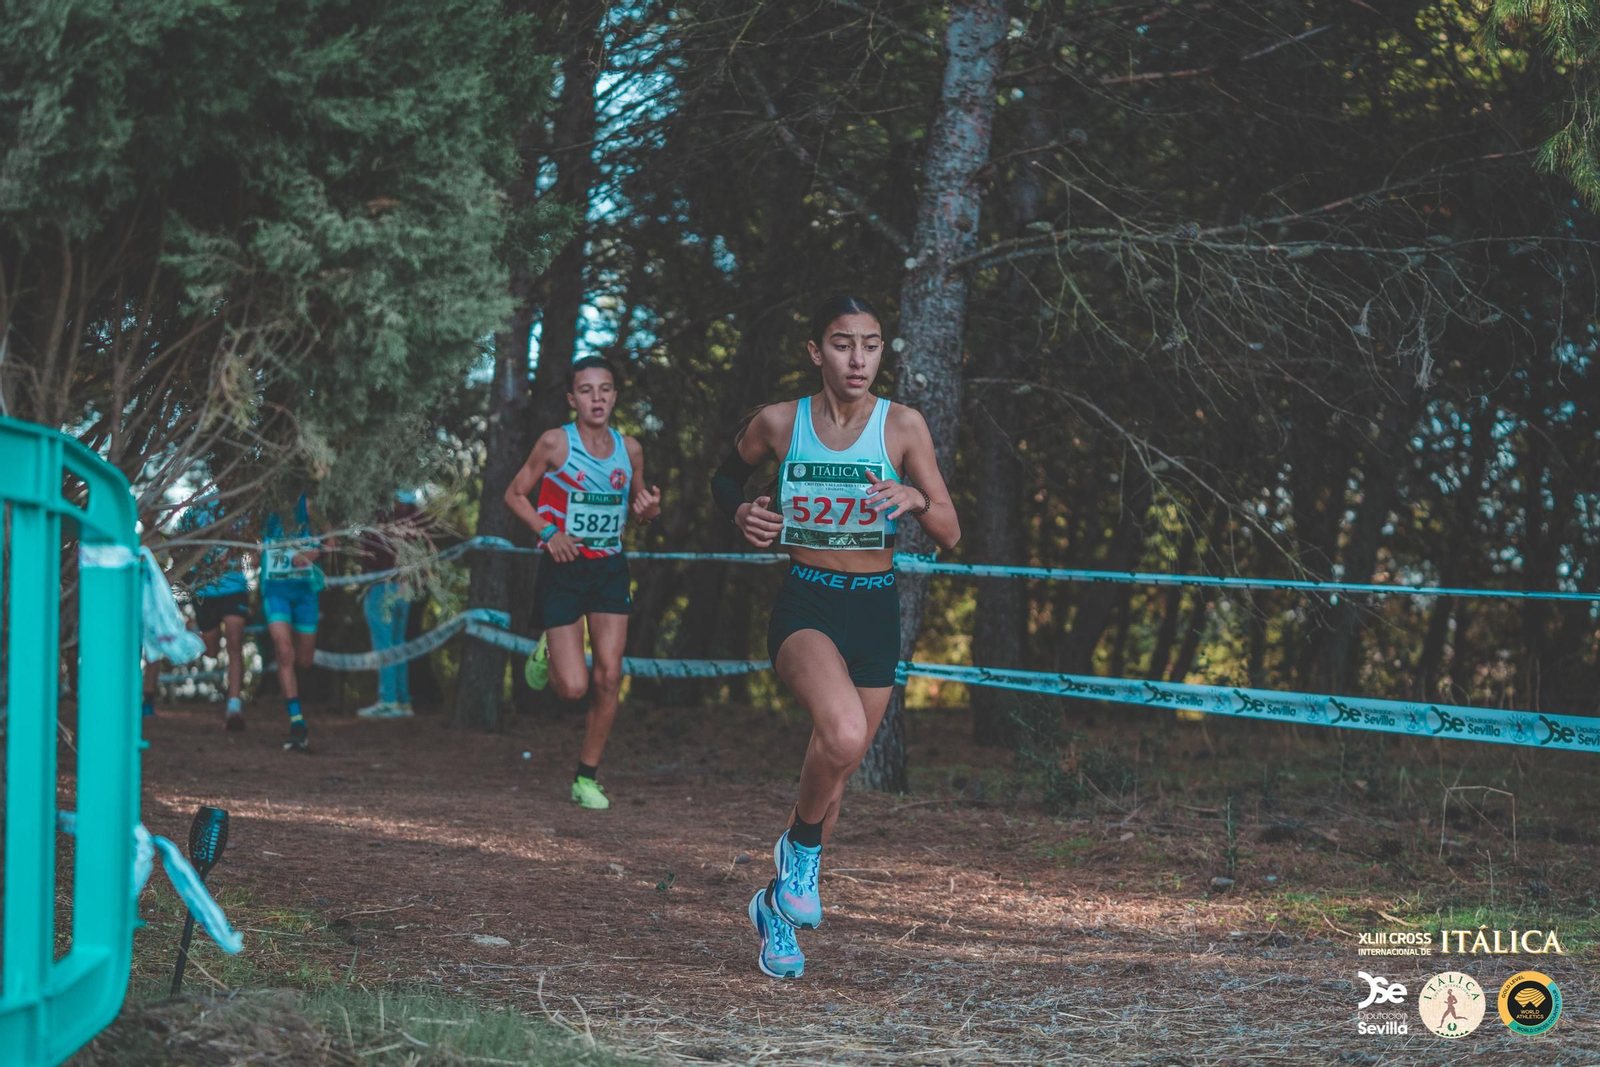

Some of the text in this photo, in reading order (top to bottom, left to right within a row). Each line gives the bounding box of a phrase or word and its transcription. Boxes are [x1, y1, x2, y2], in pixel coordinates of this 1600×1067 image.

[812, 464, 860, 477] ITÁLICA
[792, 496, 878, 526] 5275
[572, 513, 620, 533] 5821
[790, 565, 895, 590] NIKE PRO
[1266, 704, 1297, 717] Sevilla
[1364, 713, 1396, 727] Sevilla
[1467, 722, 1501, 738] Sevilla
